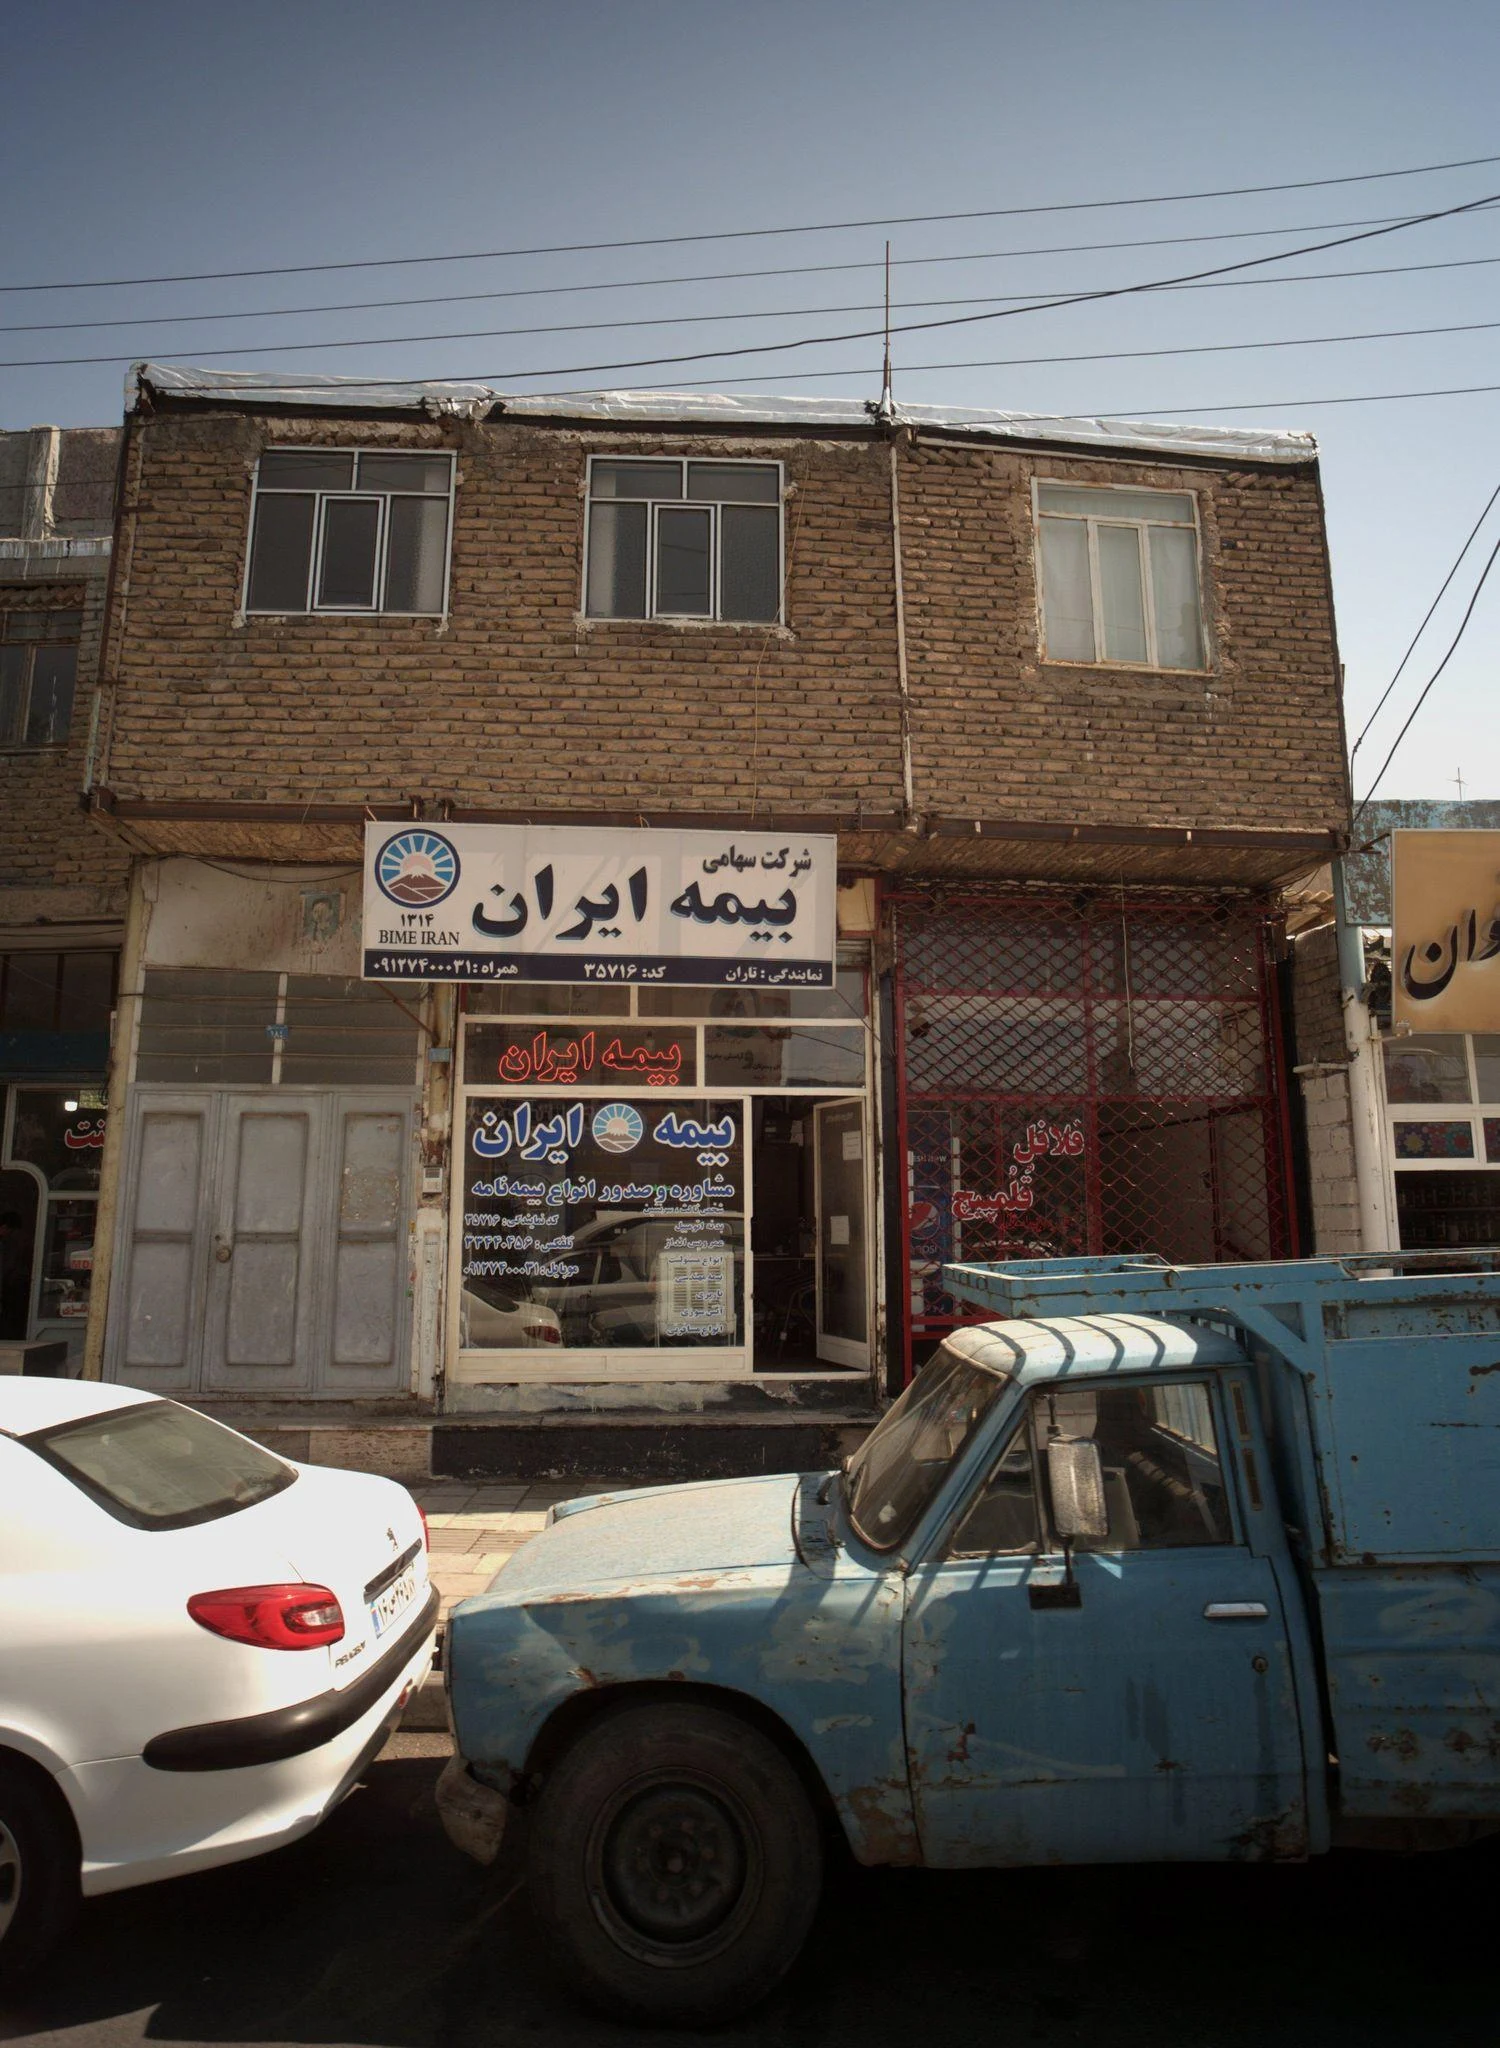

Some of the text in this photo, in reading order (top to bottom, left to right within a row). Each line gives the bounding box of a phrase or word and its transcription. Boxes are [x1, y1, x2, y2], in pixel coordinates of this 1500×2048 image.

[703, 845, 812, 877] شرکت سهامی
[471, 863, 798, 944] بیمه ایران
[400, 913, 434, 928] ۱۳۱۴
[378, 929, 460, 946] BIME IRAN
[584, 963, 636, 979] ۳۵۷۱۶
[726, 966, 757, 982] تاران
[499, 1031, 683, 1085] بیمه ایران
[472, 1102, 736, 1166] بیمه ایران
[546, 1176, 596, 1206] انواع
[598, 1182, 654, 1202] صدور
[670, 1173, 735, 1202] مشاوره
[464, 1213, 501, 1227] ۳۵۷۱۶
[546, 1213, 560, 1226] کد
